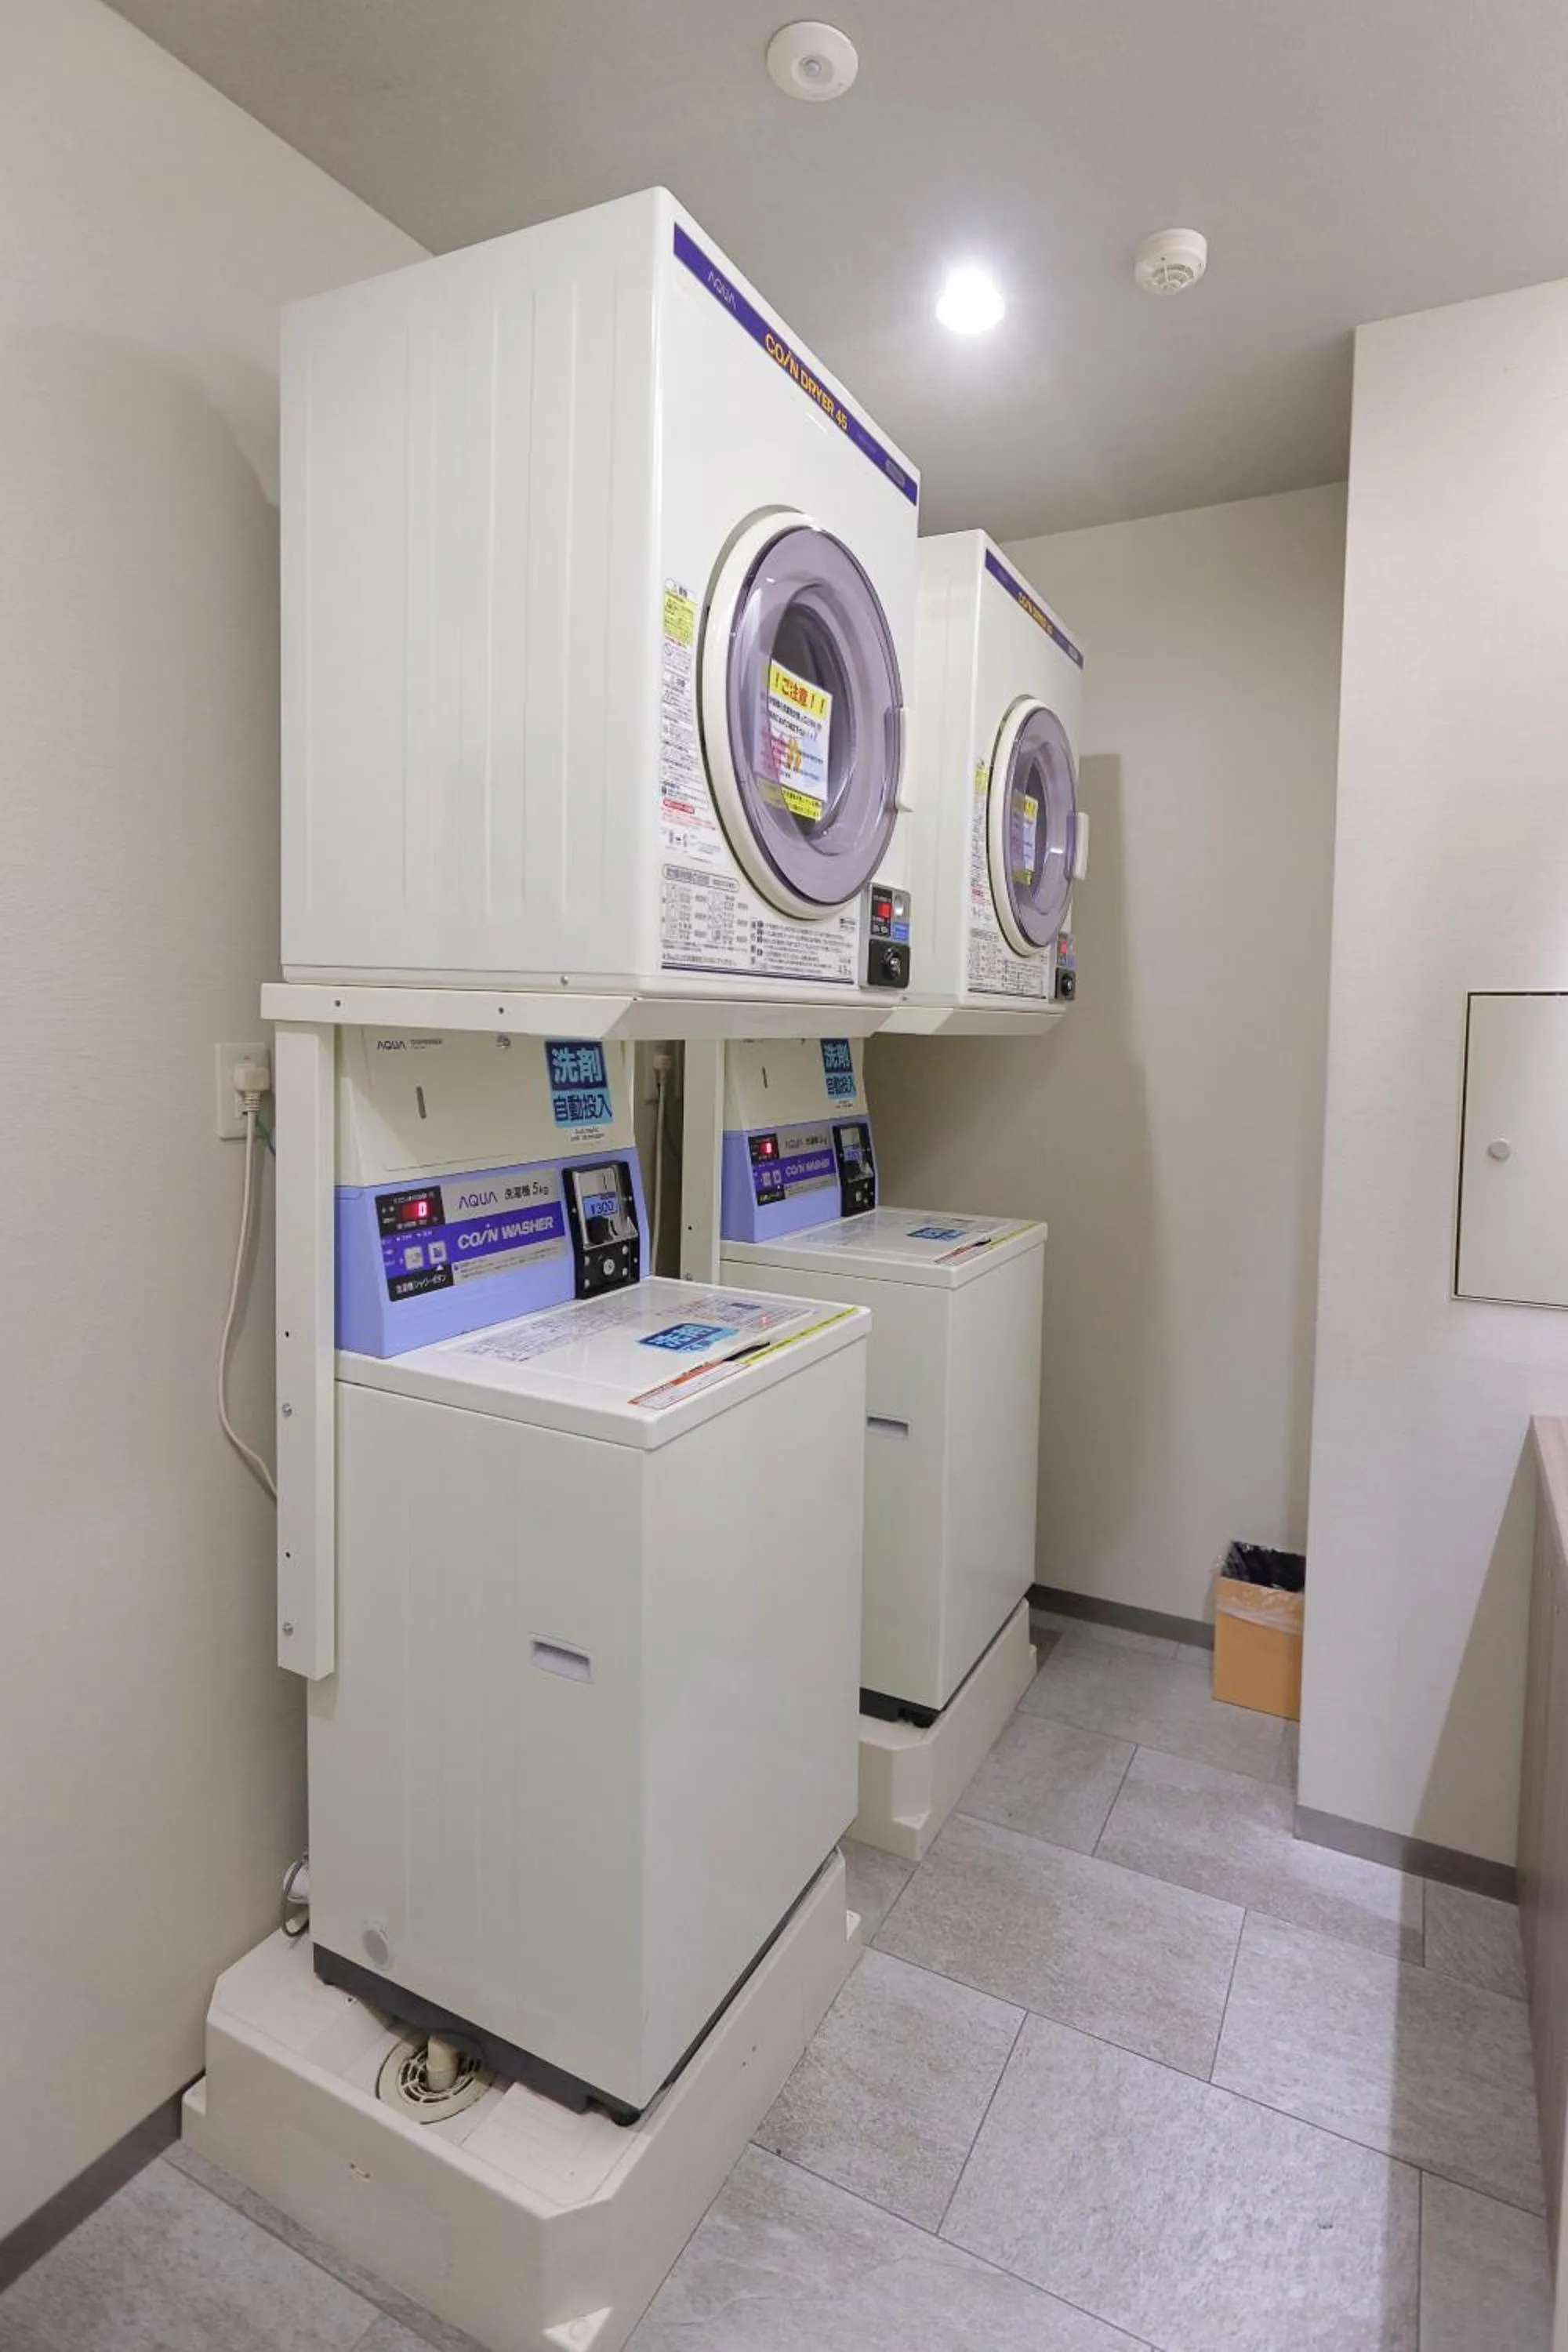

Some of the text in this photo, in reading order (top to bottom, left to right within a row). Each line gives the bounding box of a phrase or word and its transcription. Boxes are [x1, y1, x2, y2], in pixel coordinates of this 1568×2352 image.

[764, 333, 799, 380] COIN
[800, 369, 835, 418] DRYER
[550, 1047, 603, 1083] 洗剤
[553, 1093, 613, 1122] 自動投入
[417, 1201, 428, 1217] 0
[458, 1190, 499, 1210] AQUA
[457, 1222, 499, 1250] COIN
[501, 1215, 554, 1240] WASHER
